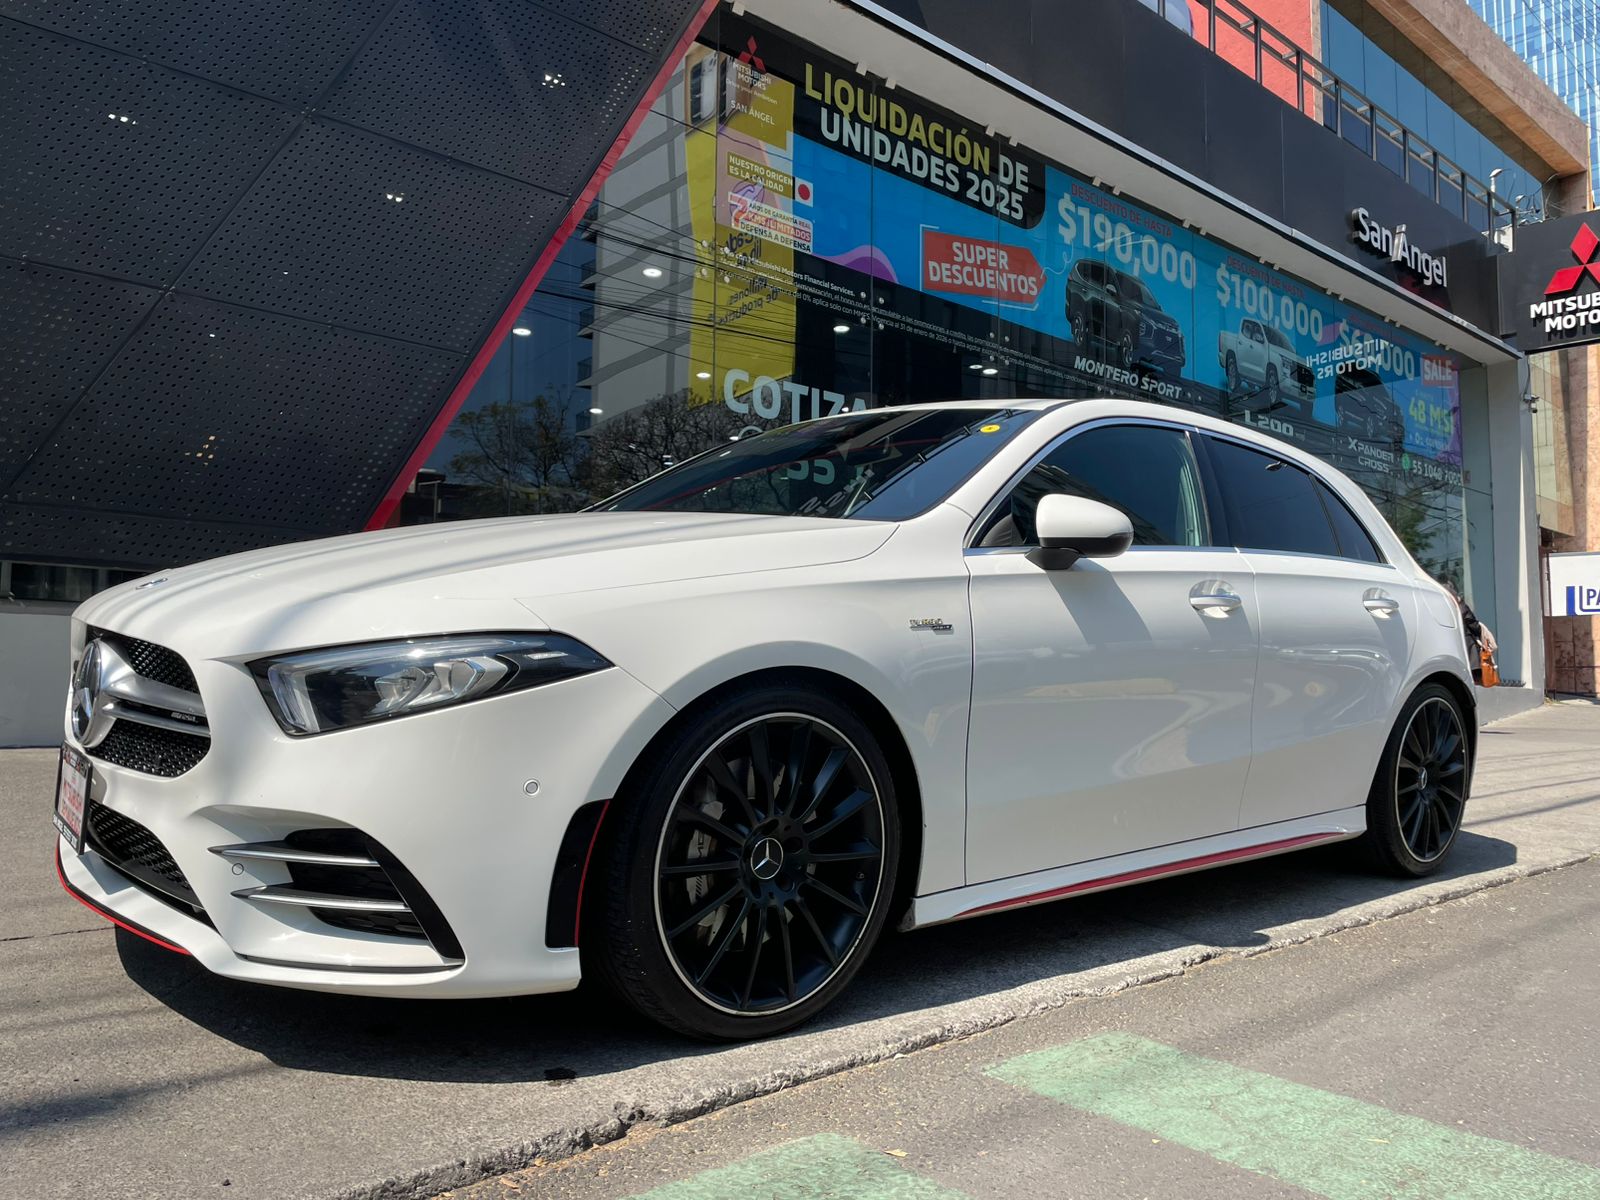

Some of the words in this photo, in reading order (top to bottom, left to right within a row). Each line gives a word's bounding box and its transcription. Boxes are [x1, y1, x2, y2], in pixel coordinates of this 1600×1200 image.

[733, 62, 772, 85] MITSUBISHI
[738, 72, 767, 91] MOTORS
[731, 100, 748, 113] SAN
[805, 63, 990, 176] LIQUIDACIÓN
[999, 154, 1029, 193] DE
[729, 155, 765, 175] NUESTRO
[766, 171, 793, 186] ORIGEN
[821, 107, 960, 193] UNIDADES
[966, 171, 1024, 220] 2025
[729, 165, 739, 175] ES
[741, 171, 751, 180] LA
[752, 175, 784, 192] CALIDAD
[1071, 183, 1128, 219] DESCUENTO
[1130, 210, 1140, 226] DE
[1143, 217, 1173, 238] HASTA
[740, 222, 773, 239] DEFENSA
[780, 236, 811, 252] DEFENSA
[1058, 192, 1197, 289] $190,000
[1352, 207, 1392, 257] San
[1391, 223, 1448, 288] Ángel
[952, 241, 1009, 270] SUPER
[782, 267, 804, 280] Motors
[804, 275, 830, 288] Financial
[831, 283, 856, 297] Services.
[928, 260, 1038, 296] DESCUENTOS
[1216, 263, 1323, 342] $100,000
[1529, 291, 1600, 319] MITSUB
[1545, 309, 1600, 333] MOTO
[1074, 356, 1139, 387] MONTERO
[1140, 375, 1183, 400] SPORT
[1423, 359, 1453, 381] SALE
[1244, 409, 1294, 437] L200
[1409, 397, 1427, 424] 48
[1348, 436, 1395, 464] XPANDER
[1358, 456, 1391, 474] CROSS
